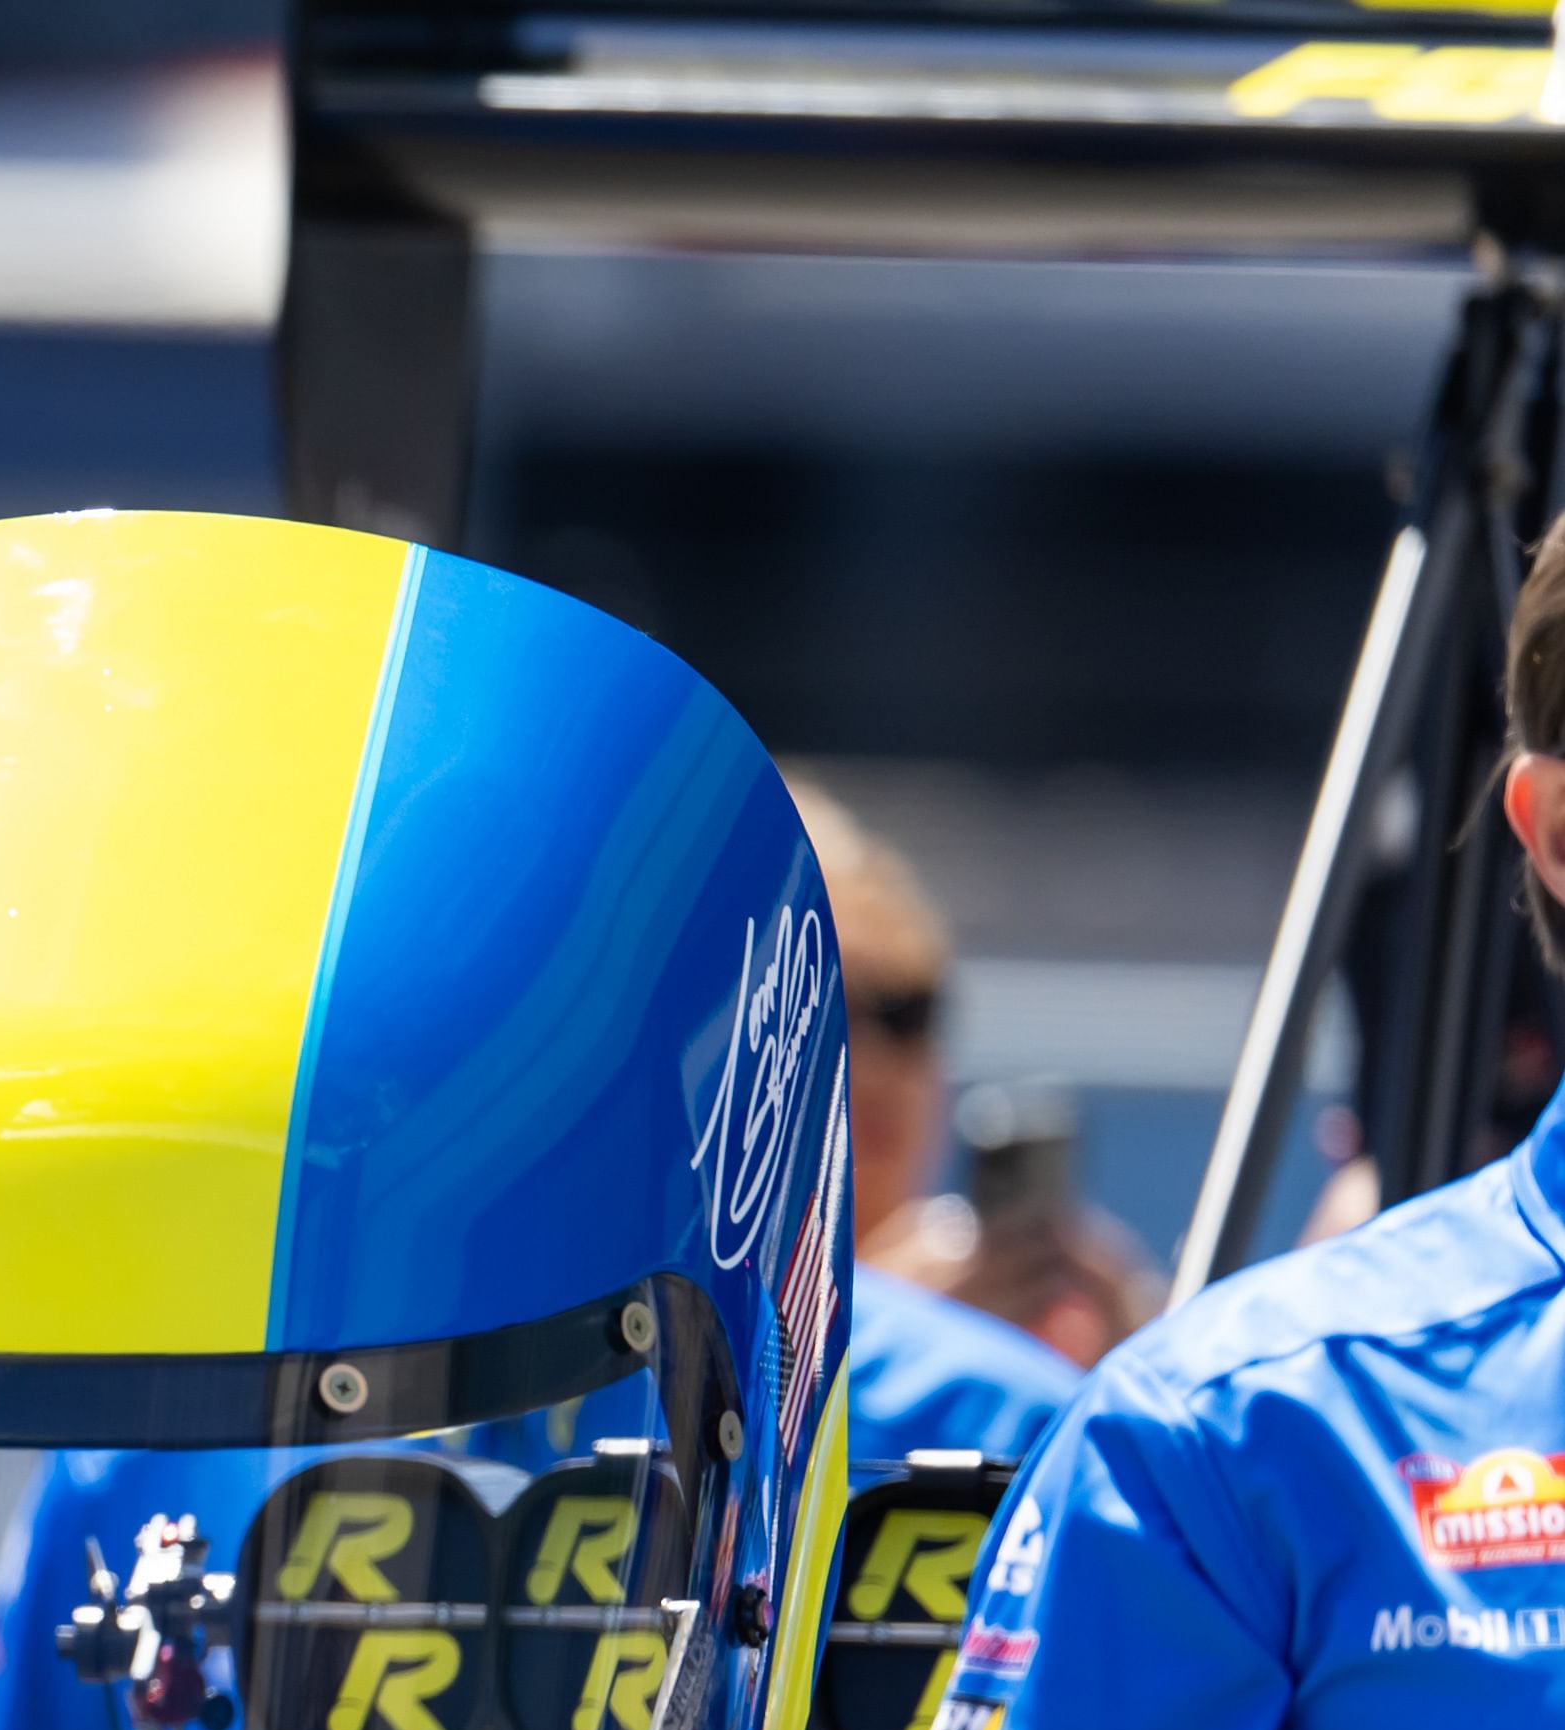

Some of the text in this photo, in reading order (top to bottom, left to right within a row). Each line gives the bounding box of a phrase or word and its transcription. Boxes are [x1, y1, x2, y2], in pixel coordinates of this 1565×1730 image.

[277, 1492, 415, 1602] R
[527, 1495, 638, 1606] R
[1370, 1604, 1511, 1652] Mobil
